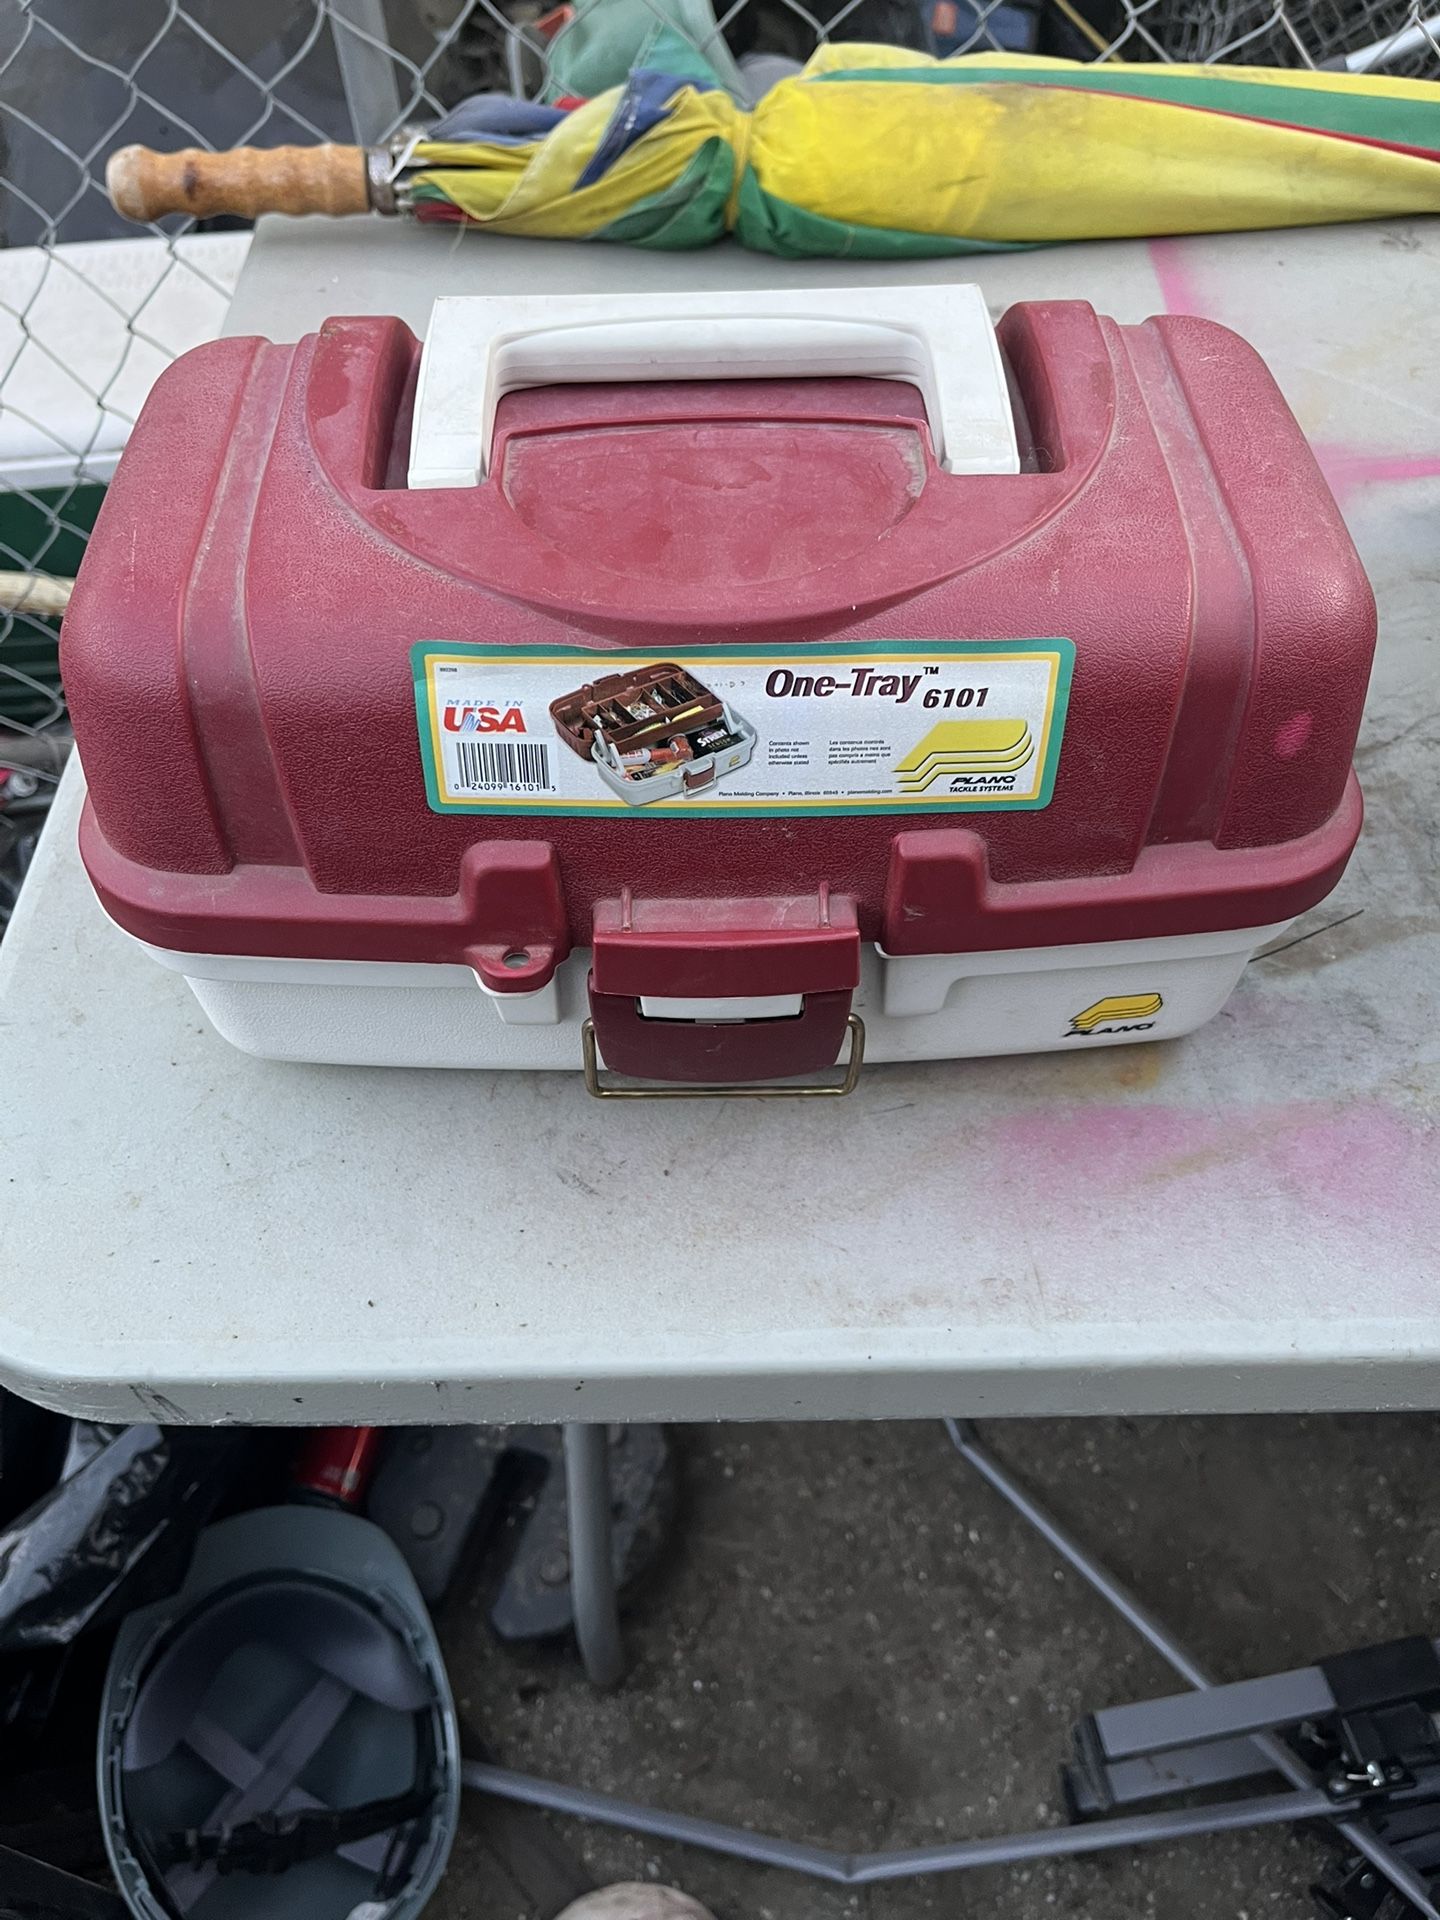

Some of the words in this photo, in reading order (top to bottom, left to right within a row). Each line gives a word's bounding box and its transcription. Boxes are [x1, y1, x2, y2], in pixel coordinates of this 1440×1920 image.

[923, 687, 989, 709] 6101
[443, 706, 527, 733] USA
[951, 775, 1016, 785] PLANO
[471, 782, 503, 791] 24099
[509, 783, 540, 792] 16101
[949, 785, 977, 793] TACKLE
[978, 784, 1014, 792] SYSTEMS
